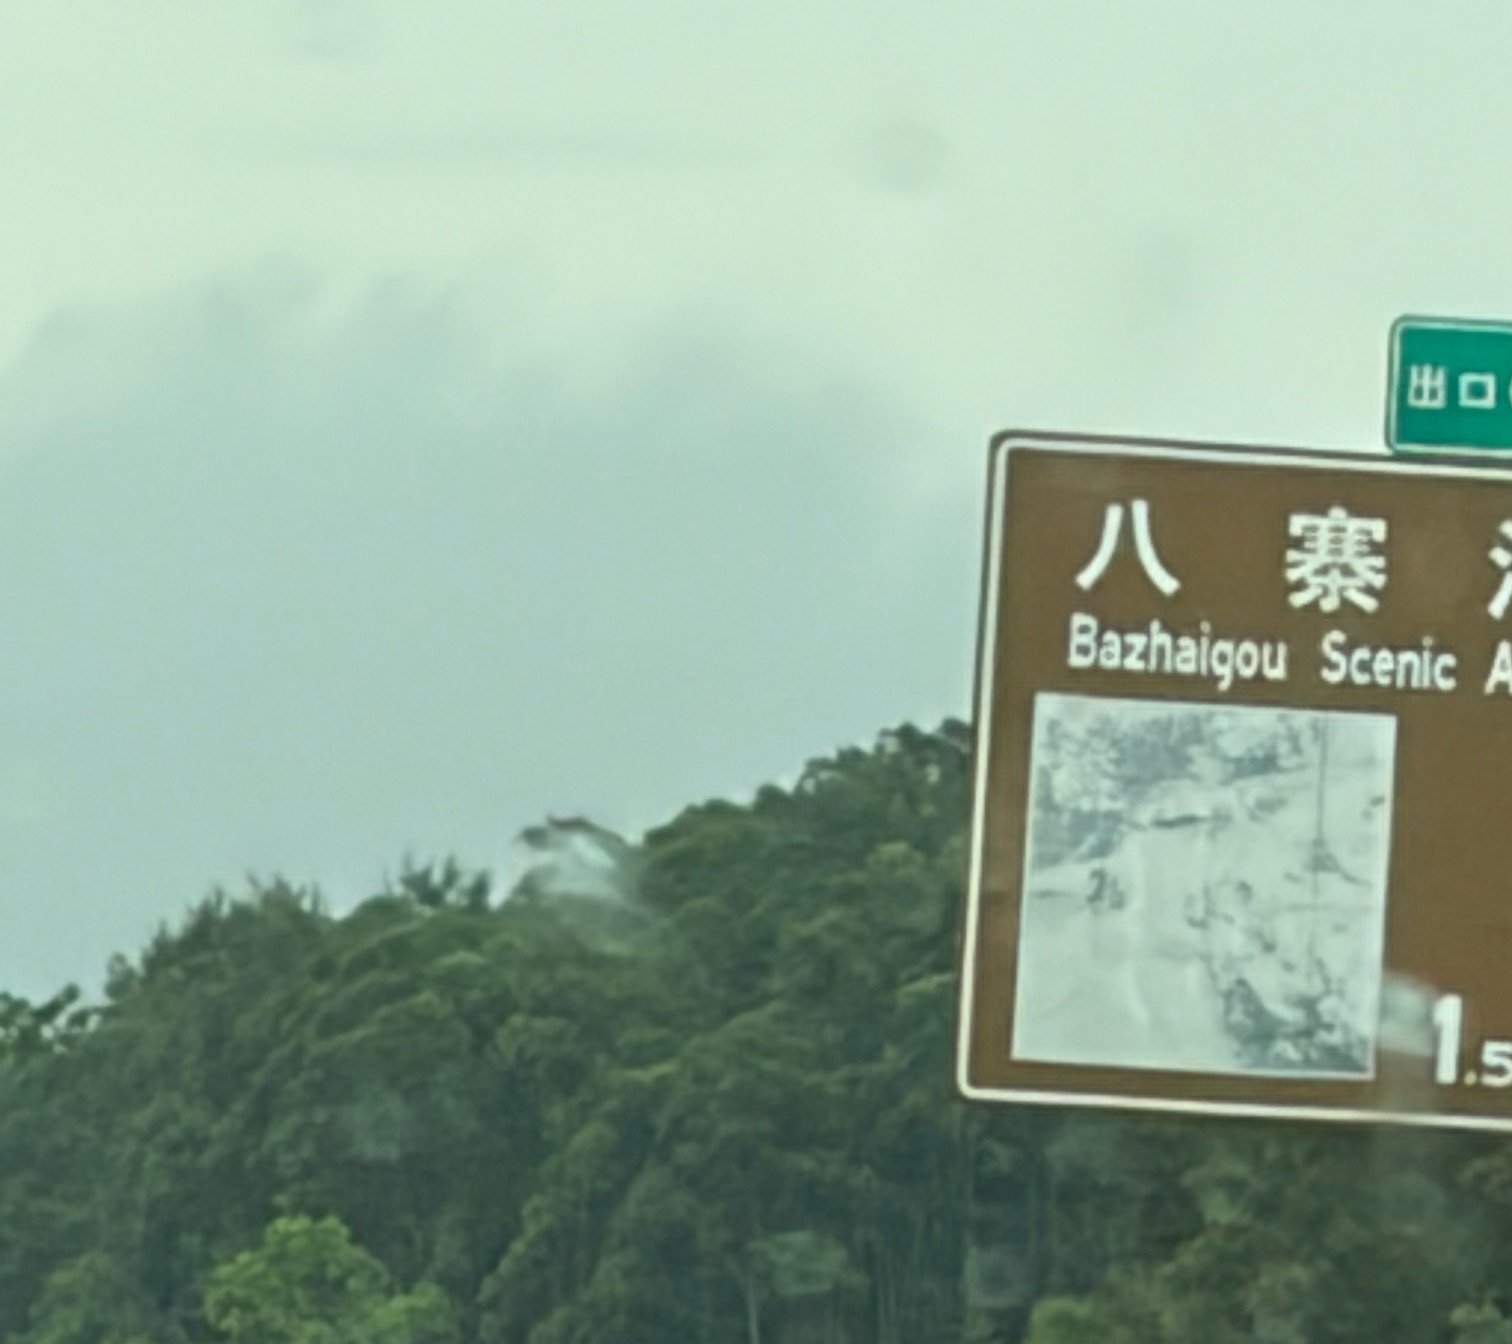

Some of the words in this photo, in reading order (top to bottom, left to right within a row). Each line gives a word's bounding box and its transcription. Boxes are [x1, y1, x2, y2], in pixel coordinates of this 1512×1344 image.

[1407, 363, 1497, 410] 出口
[1066, 612, 1288, 692] Bazhaigou
[1320, 629, 1458, 691] Scenic
